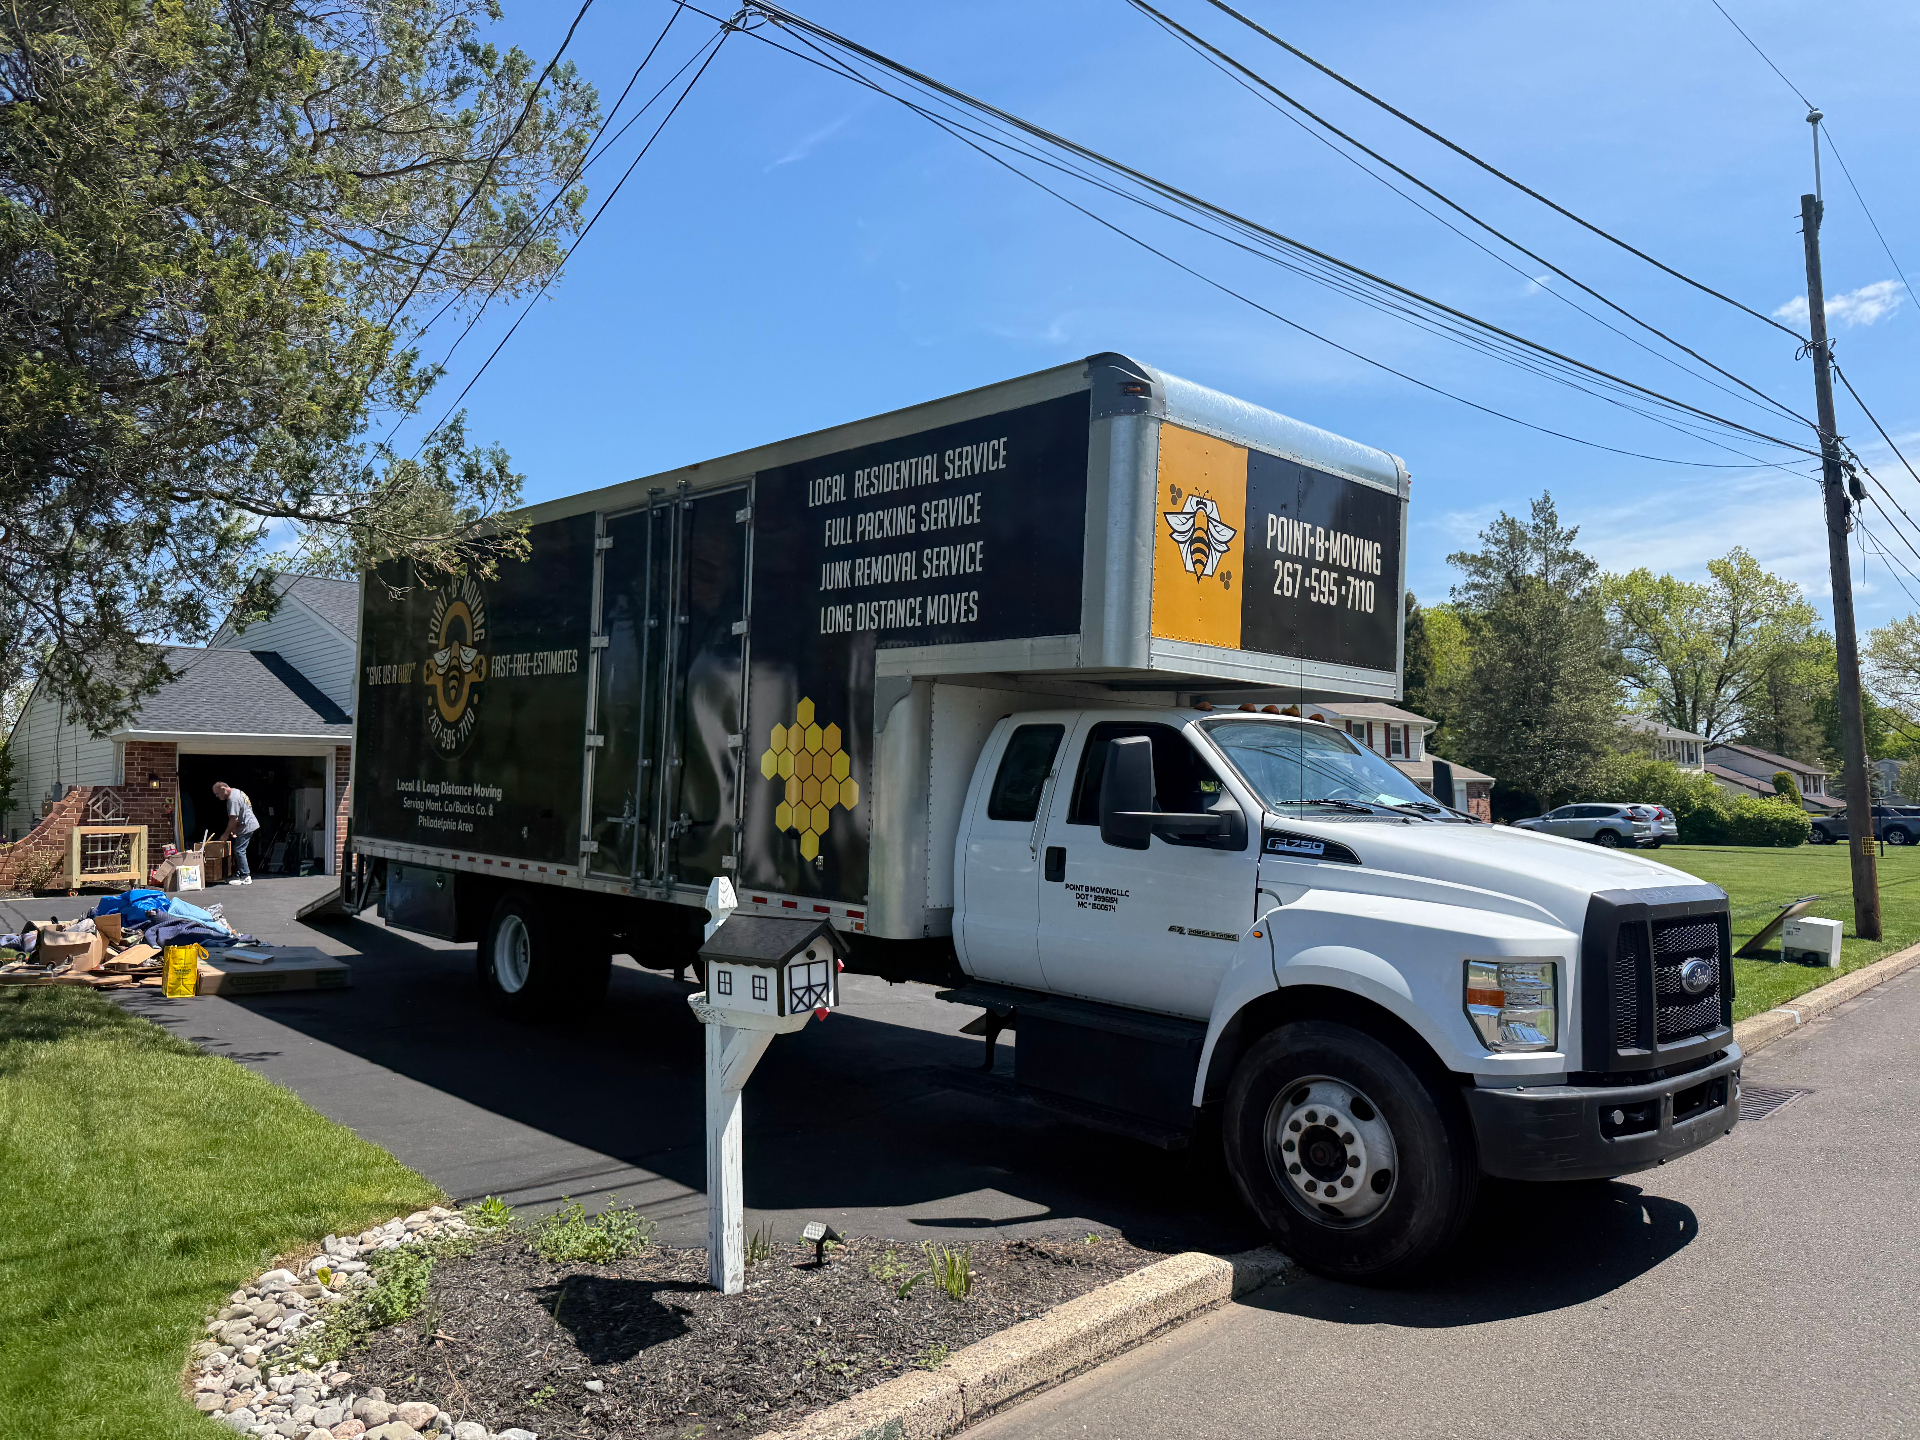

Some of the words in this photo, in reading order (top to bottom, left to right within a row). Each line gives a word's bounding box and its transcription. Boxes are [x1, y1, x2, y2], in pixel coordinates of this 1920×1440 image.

[808, 473, 847, 508] LOCAL
[854, 453, 939, 499] RESIDENTIAL
[944, 436, 1008, 480] SERVICE
[824, 515, 853, 547] FULL
[856, 504, 916, 542] PACKING
[920, 492, 982, 532] SERVICE
[819, 559, 851, 591] JUNK
[854, 550, 918, 587] REMOVAL
[922, 540, 984, 579] SERVICE
[820, 603, 853, 635] LONG
[856, 596, 923, 631] DISTANCE
[926, 590, 979, 626] MOVES
[397, 778, 415, 792] Local
[416, 780, 421, 793] &
[422, 780, 440, 797] Long
[441, 781, 473, 796] Distance
[473, 783, 503, 802] Moving
[403, 796, 425, 813] Serving
[425, 798, 443, 812] Mont.
[444, 800, 475, 815] Co/Bucks
[475, 802, 487, 816] Co.
[418, 815, 457, 832] Philadelphia
[457, 819, 474, 833] Area
[1065, 883, 1084, 892] POINT
[1090, 886, 1116, 896] MOVING
[1116, 888, 1130, 897] LLC
[1075, 892, 1089, 900] DOT
[1077, 900, 1087, 909] MC
